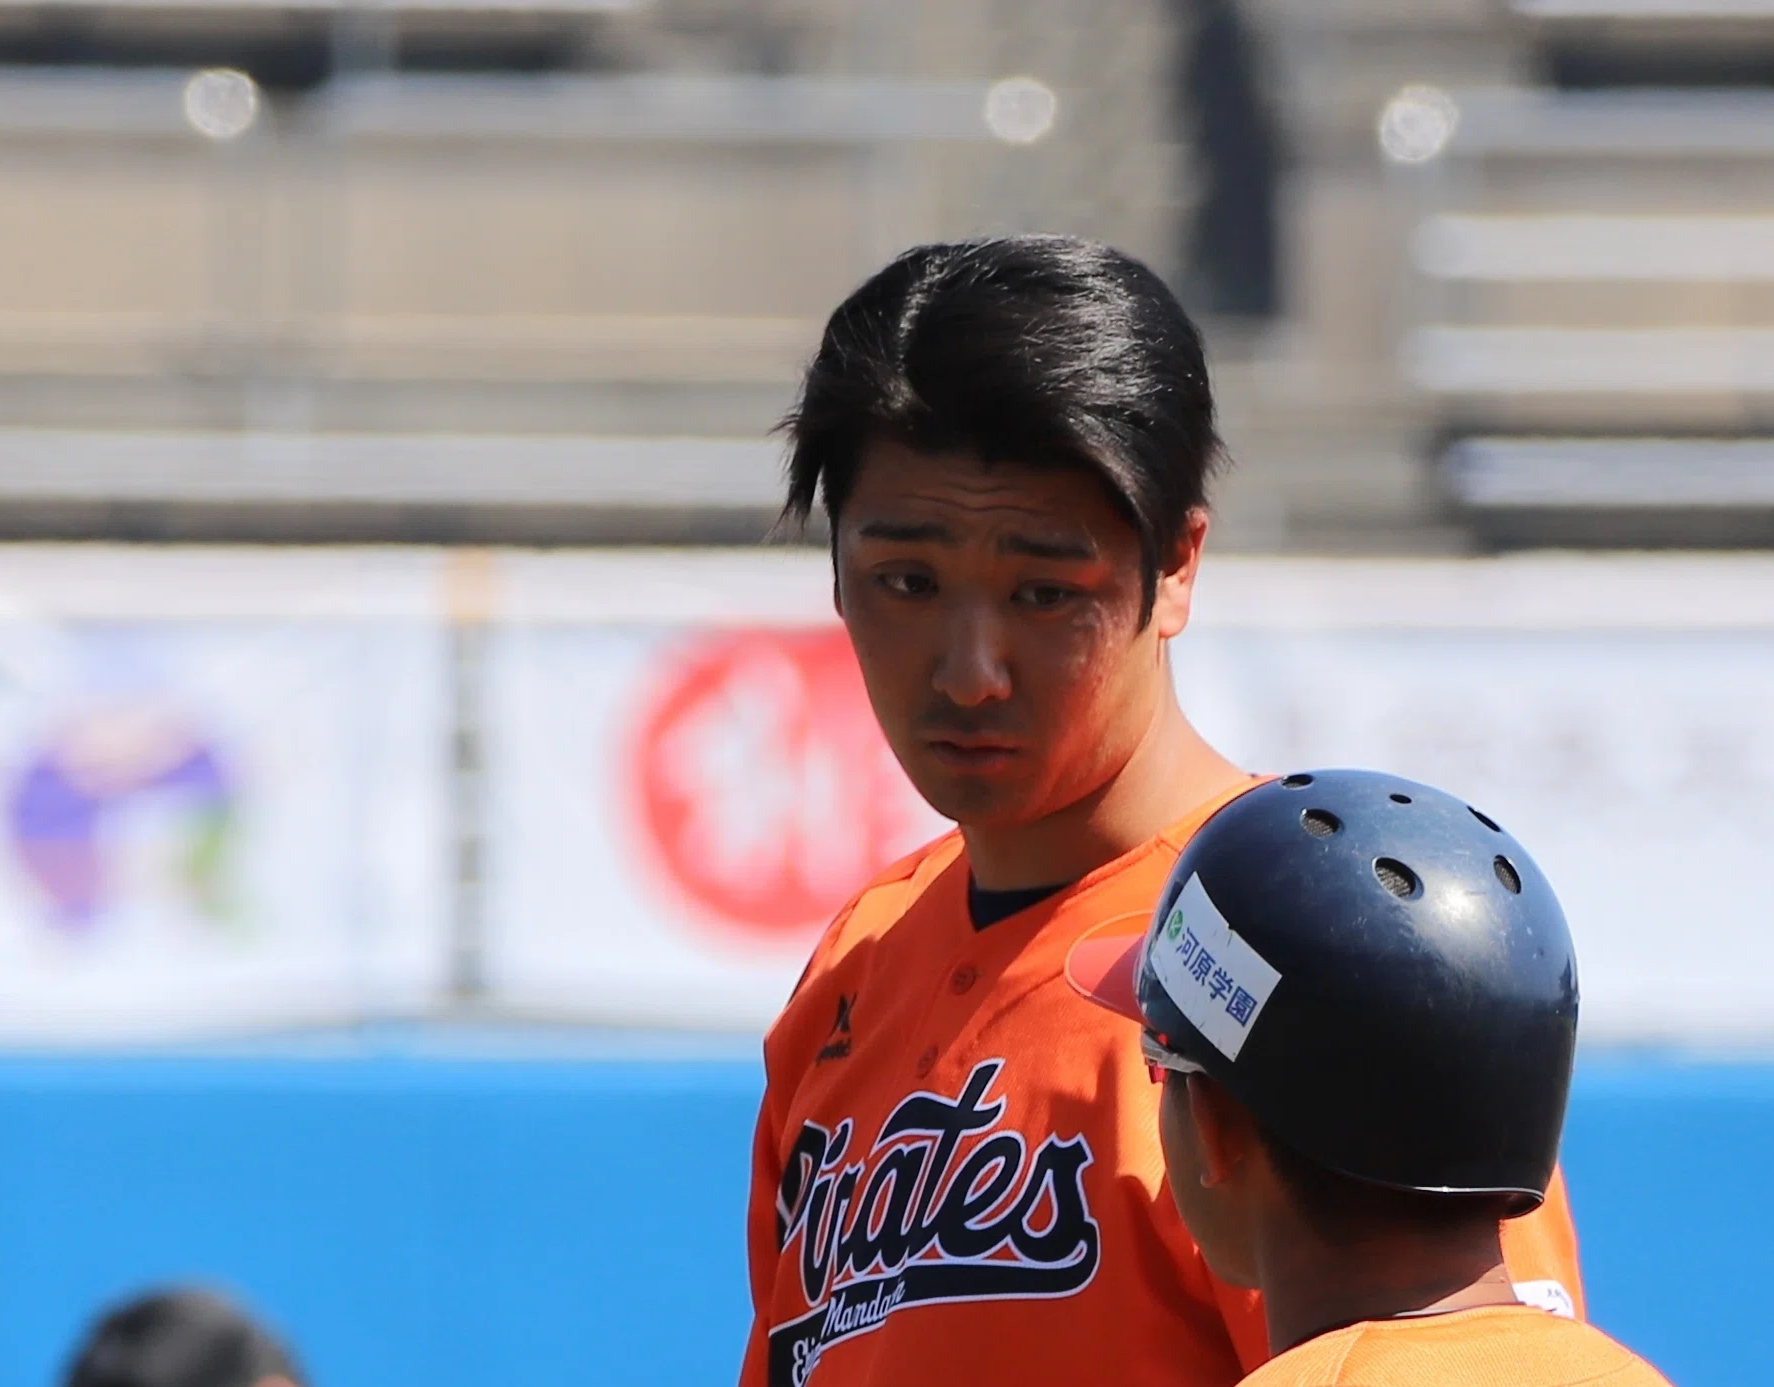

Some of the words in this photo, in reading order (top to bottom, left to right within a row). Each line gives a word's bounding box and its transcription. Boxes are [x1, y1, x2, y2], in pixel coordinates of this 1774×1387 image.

[1176, 926, 1258, 1028] 河原学園
[776, 1057, 1100, 1307] Pirates
